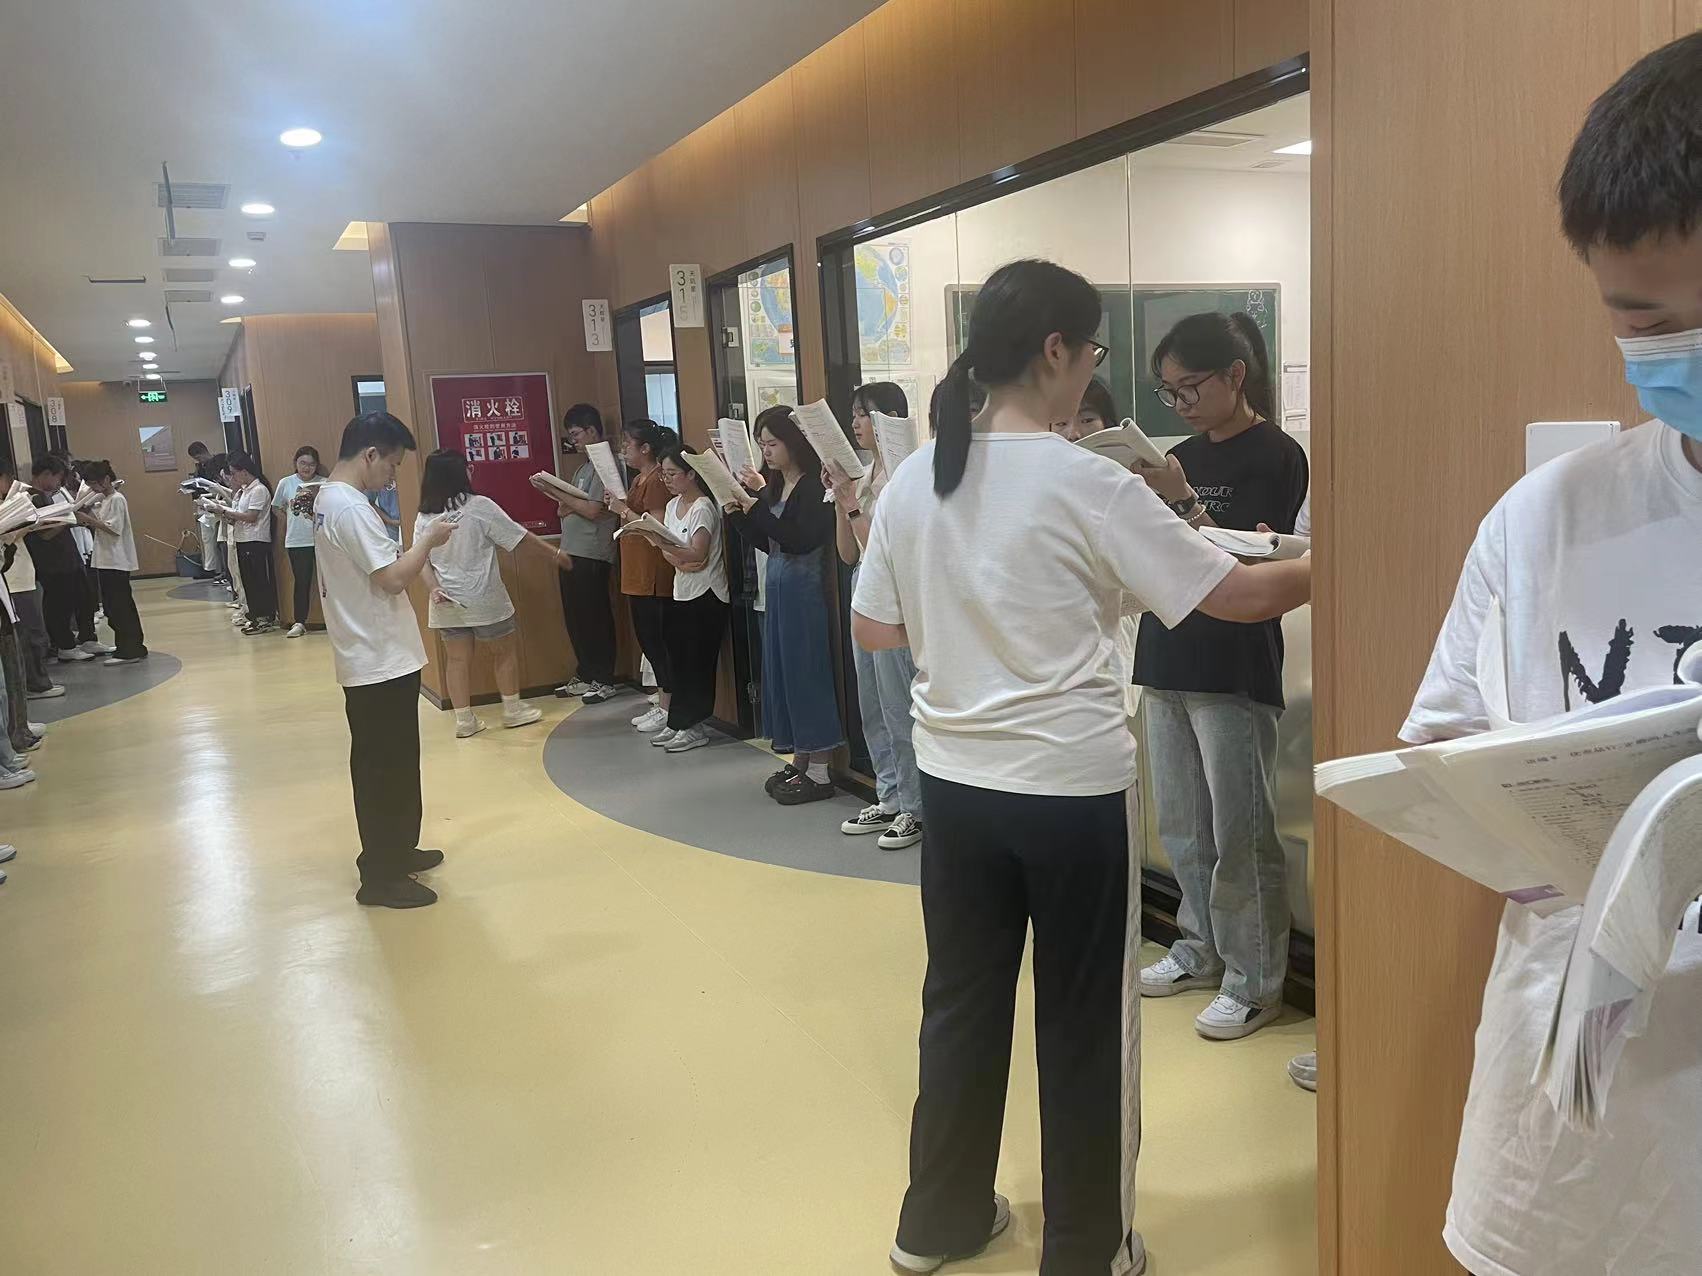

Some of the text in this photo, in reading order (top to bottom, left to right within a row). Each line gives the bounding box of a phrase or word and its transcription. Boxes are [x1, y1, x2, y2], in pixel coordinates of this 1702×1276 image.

[588, 304, 600, 346] 313
[50, 399, 58, 423] 308
[225, 390, 233, 414] 309
[465, 398, 521, 418] 消火栓
